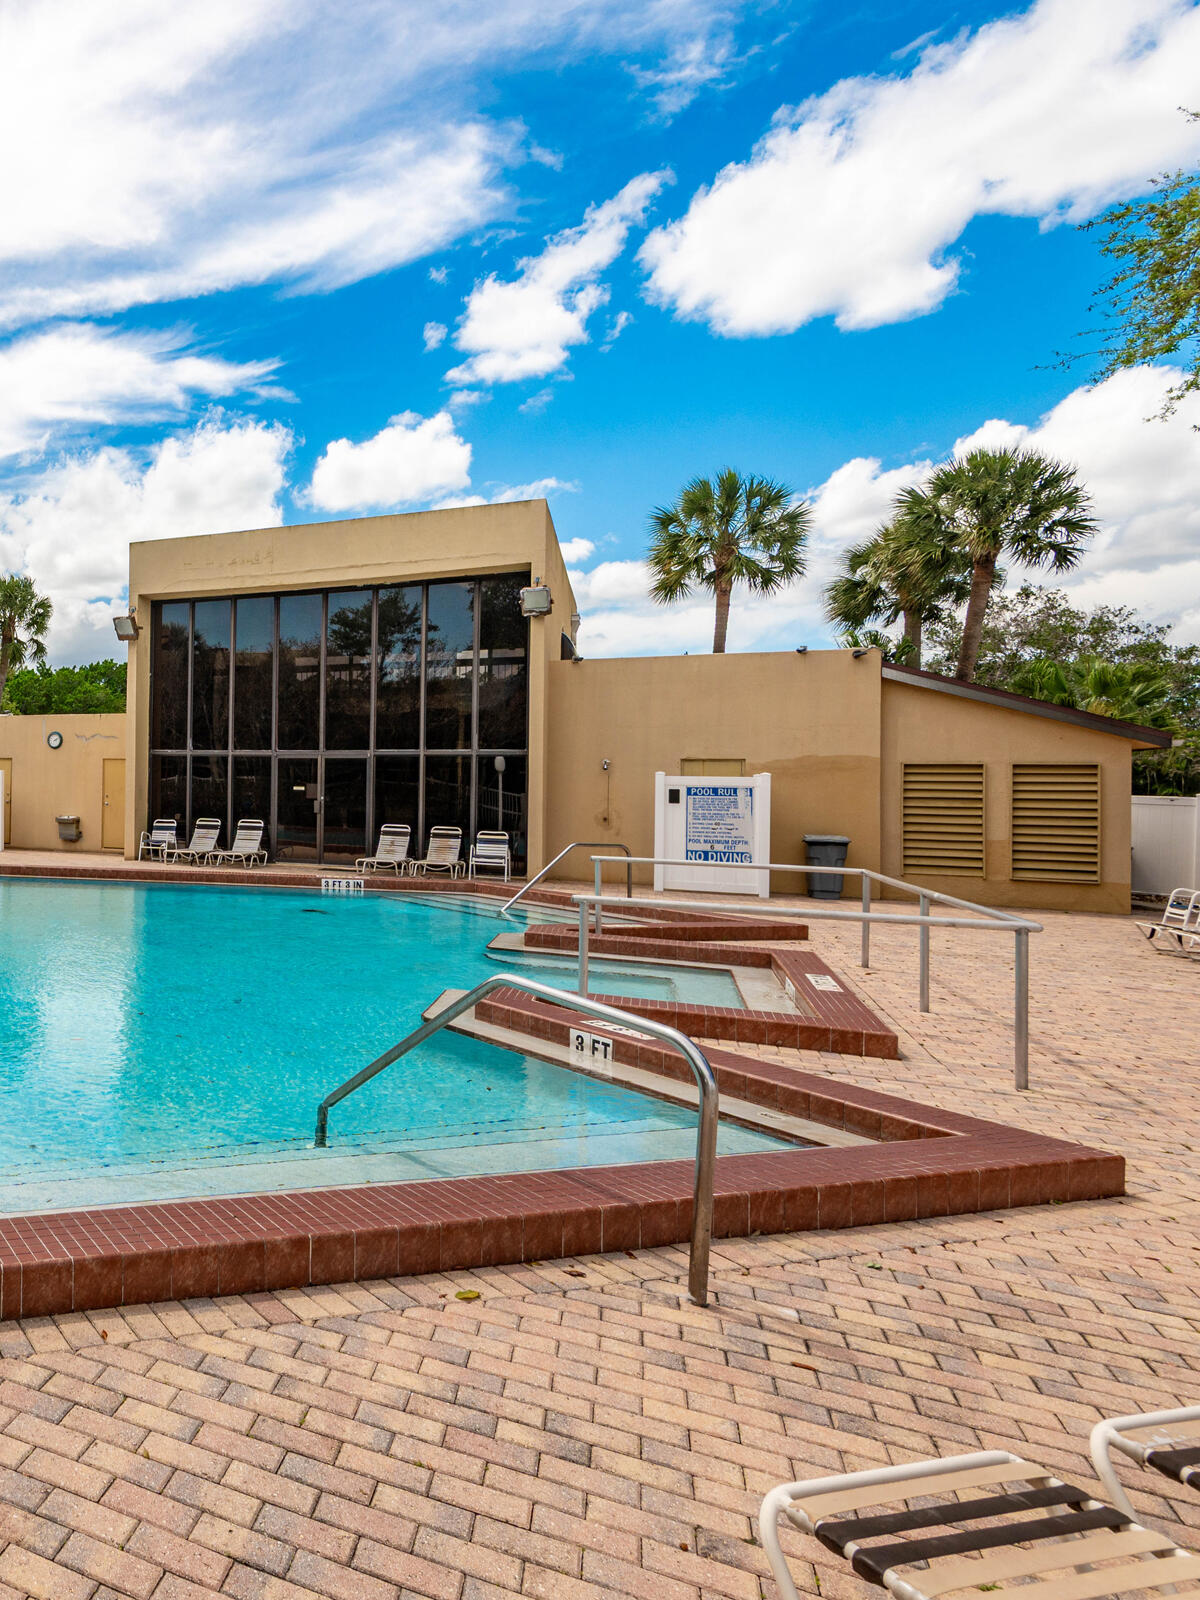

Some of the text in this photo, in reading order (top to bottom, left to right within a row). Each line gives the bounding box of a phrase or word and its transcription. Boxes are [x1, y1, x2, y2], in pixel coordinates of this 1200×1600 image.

[691, 788, 715, 796] POOL
[688, 851, 751, 864] NO DIVING
[324, 880, 330, 888] 3
[332, 880, 342, 888] FT
[353, 881, 362, 889] IN
[576, 1034, 611, 1059] 3 FT
